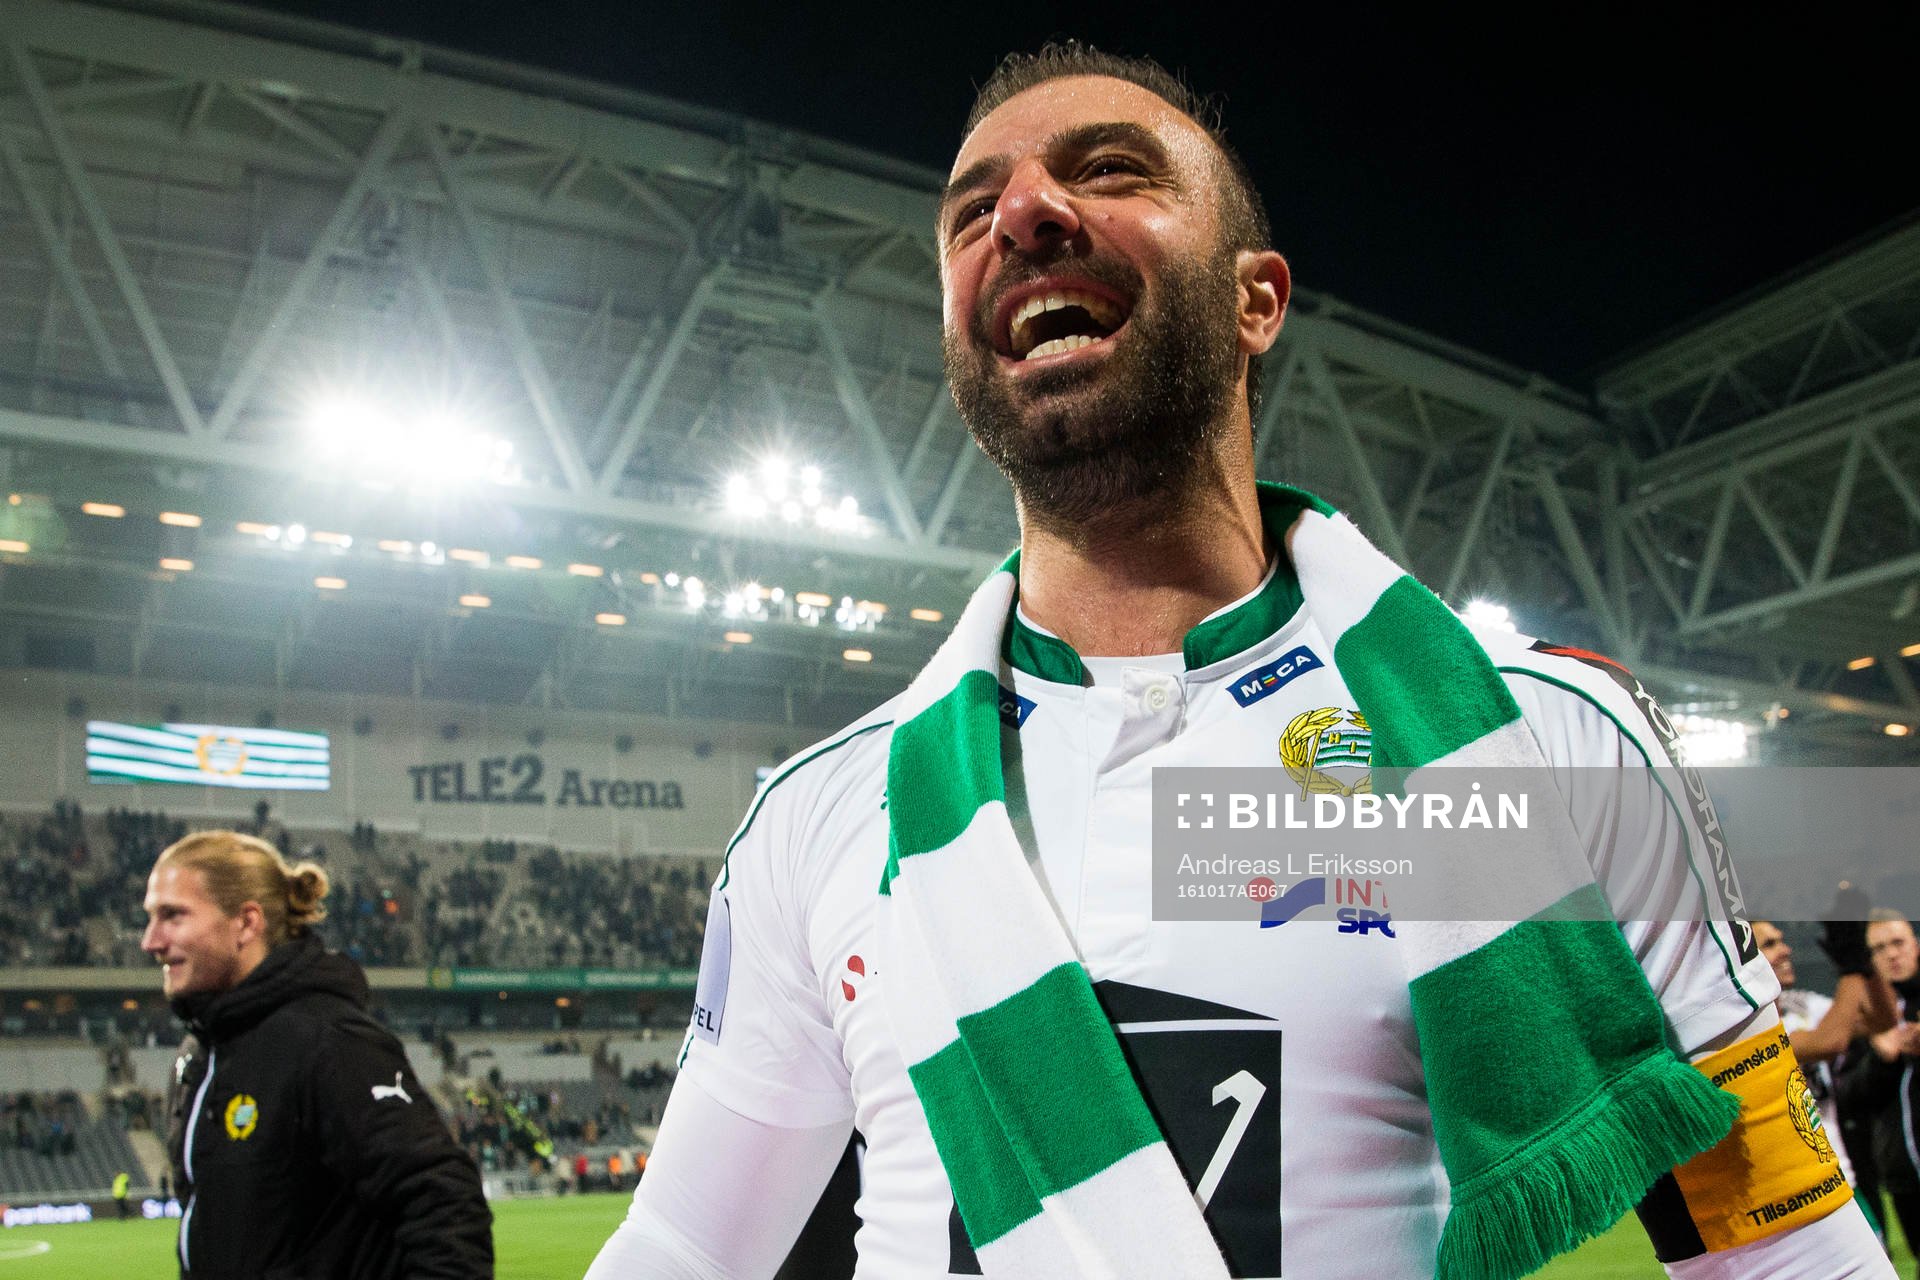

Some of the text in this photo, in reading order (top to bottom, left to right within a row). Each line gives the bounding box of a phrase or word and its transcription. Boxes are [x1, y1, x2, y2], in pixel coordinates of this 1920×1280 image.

[1240, 655, 1311, 698] MECA
[407, 753, 684, 809] TELE2 Arena
